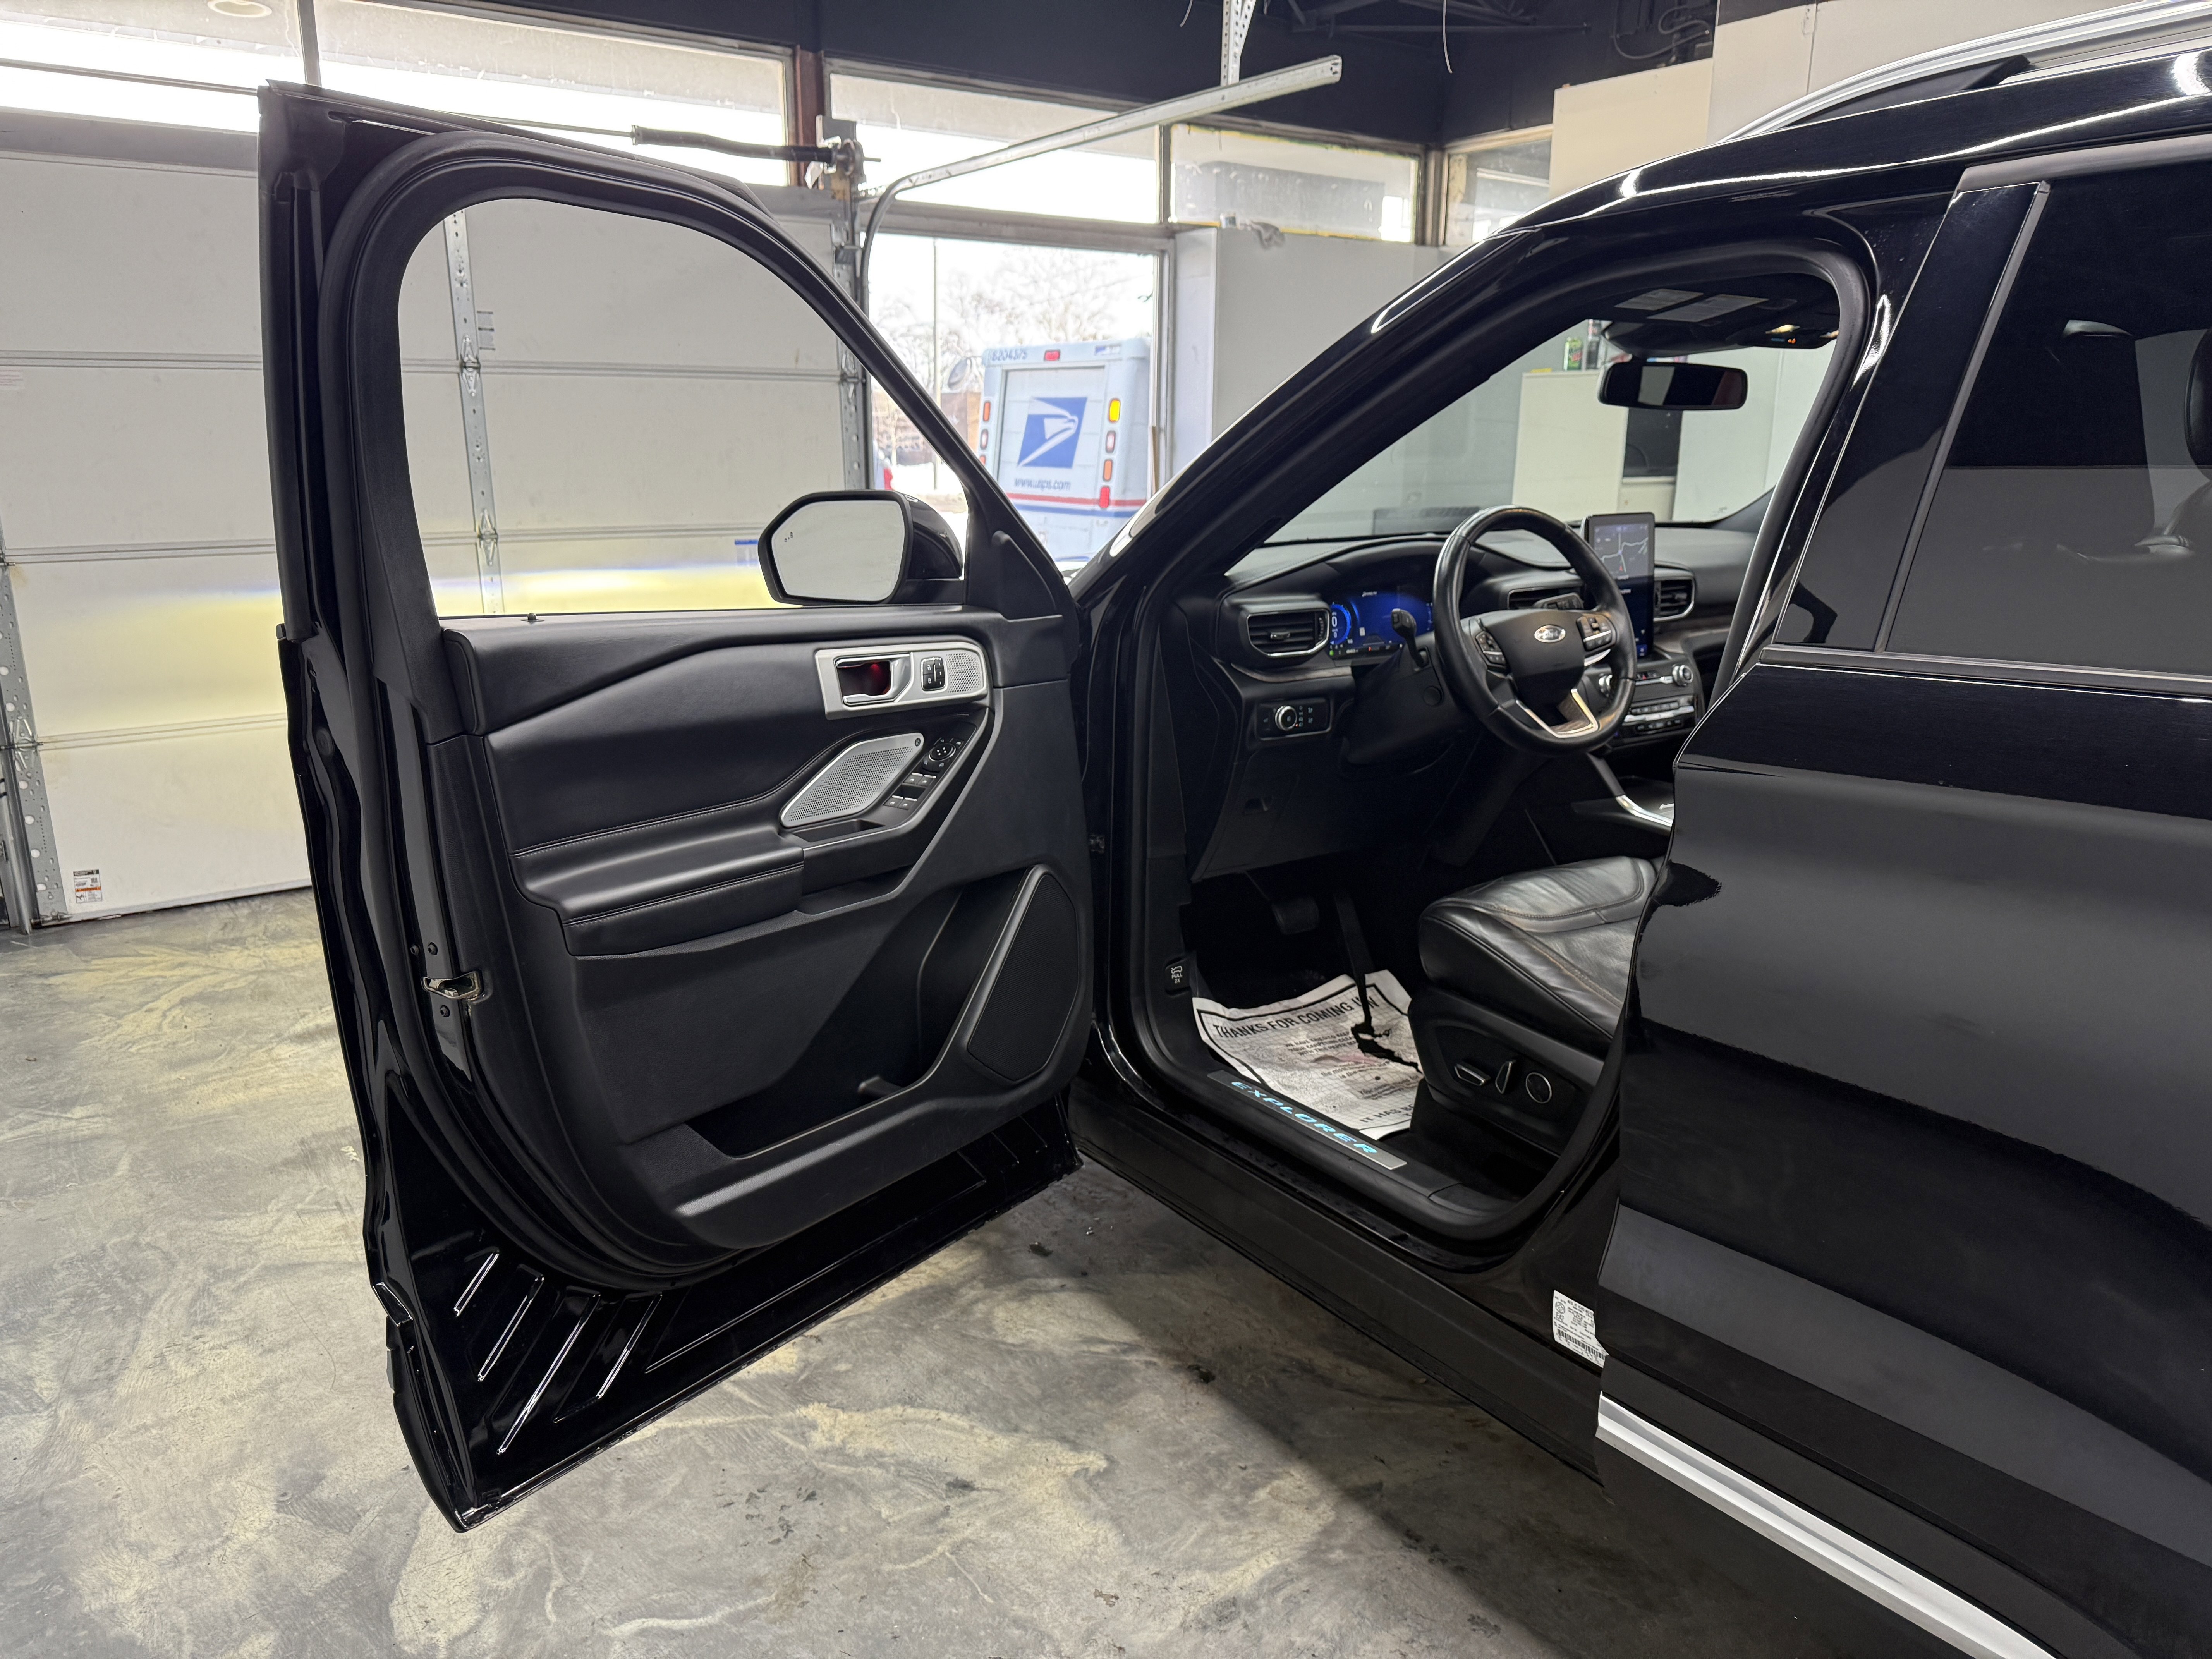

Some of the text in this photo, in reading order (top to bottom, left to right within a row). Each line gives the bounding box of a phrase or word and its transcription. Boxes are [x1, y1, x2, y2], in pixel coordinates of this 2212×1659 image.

[1213, 1023, 1268, 1039] THANKS
[1267, 1017, 1300, 1030] FOR
[1297, 1002, 1354, 1024] COMING
[1231, 1082, 1377, 1153] EXPLORER
[1373, 1109, 1401, 1118] HAS
